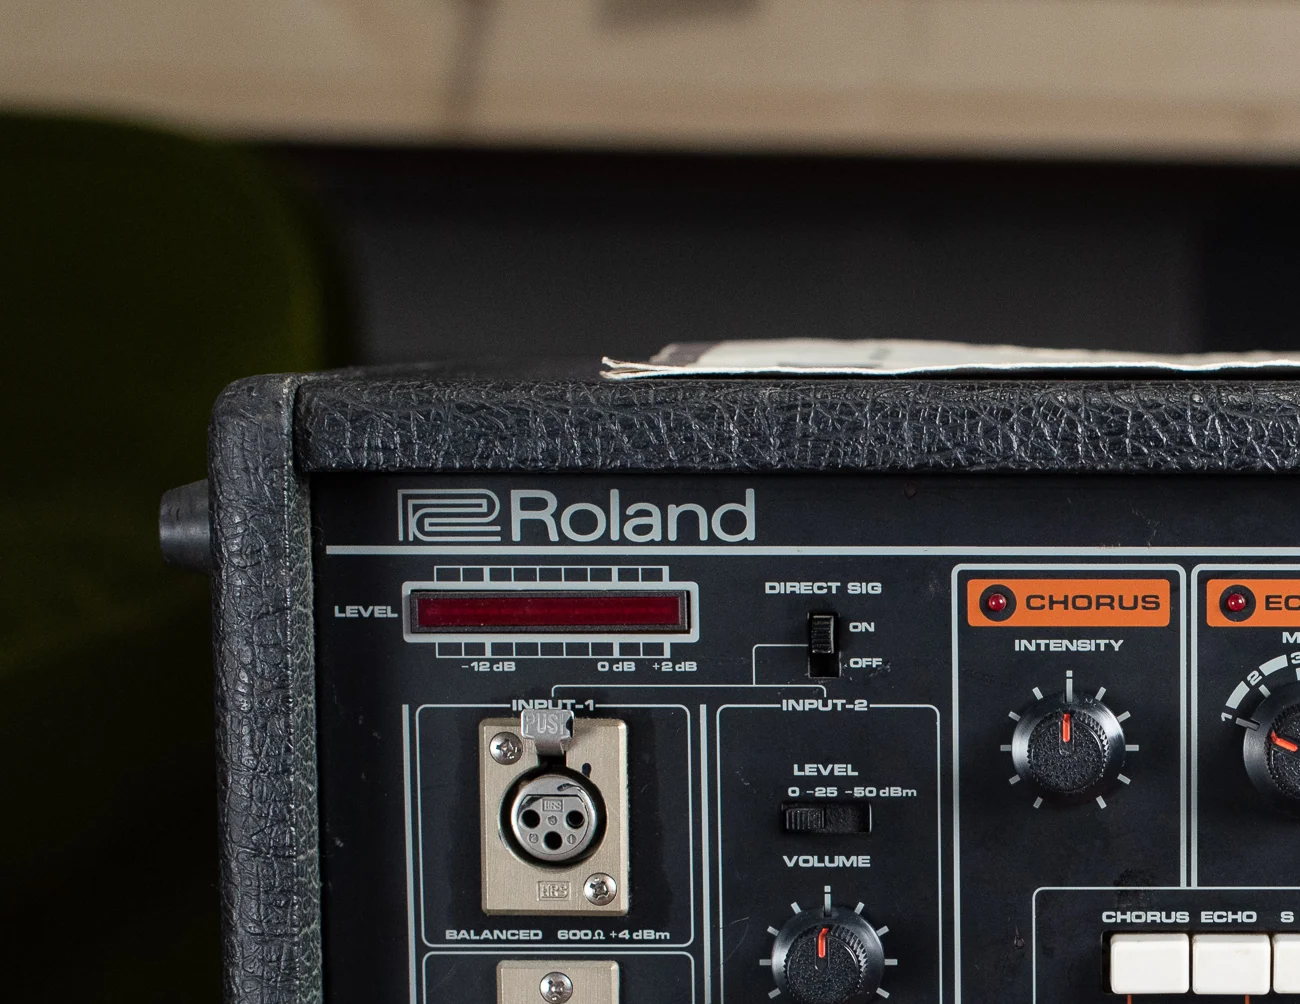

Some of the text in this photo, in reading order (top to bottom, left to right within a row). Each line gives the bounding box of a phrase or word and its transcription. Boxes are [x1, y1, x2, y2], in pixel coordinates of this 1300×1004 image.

[511, 489, 755, 542] Roland
[765, 582, 881, 594] DIRECT SIG
[1026, 595, 1160, 610] CHORUS
[335, 606, 398, 617] LEVEL
[849, 622, 874, 632] ON
[1015, 640, 1123, 651] INTENSITY
[461, 661, 516, 672] -12 dB
[597, 661, 636, 672] 0 dB
[652, 661, 698, 672] +2 dB
[850, 658, 882, 668] OFF
[1246, 670, 1262, 686] 2
[512, 699, 594, 711] INPUT-1
[783, 700, 867, 711] INPUT-2
[1220, 712, 1233, 722] 1
[794, 764, 858, 775] LEVEL
[788, 787, 917, 797] 0 -25 -50 dBm
[783, 856, 870, 867] VOLUME
[1102, 912, 1189, 923] CHORUS
[1201, 911, 1257, 922] ECHO
[1281, 911, 1294, 922] S
[446, 930, 542, 939] BALANCED
[610, 930, 630, 939] +4
[633, 930, 670, 939] dBm
